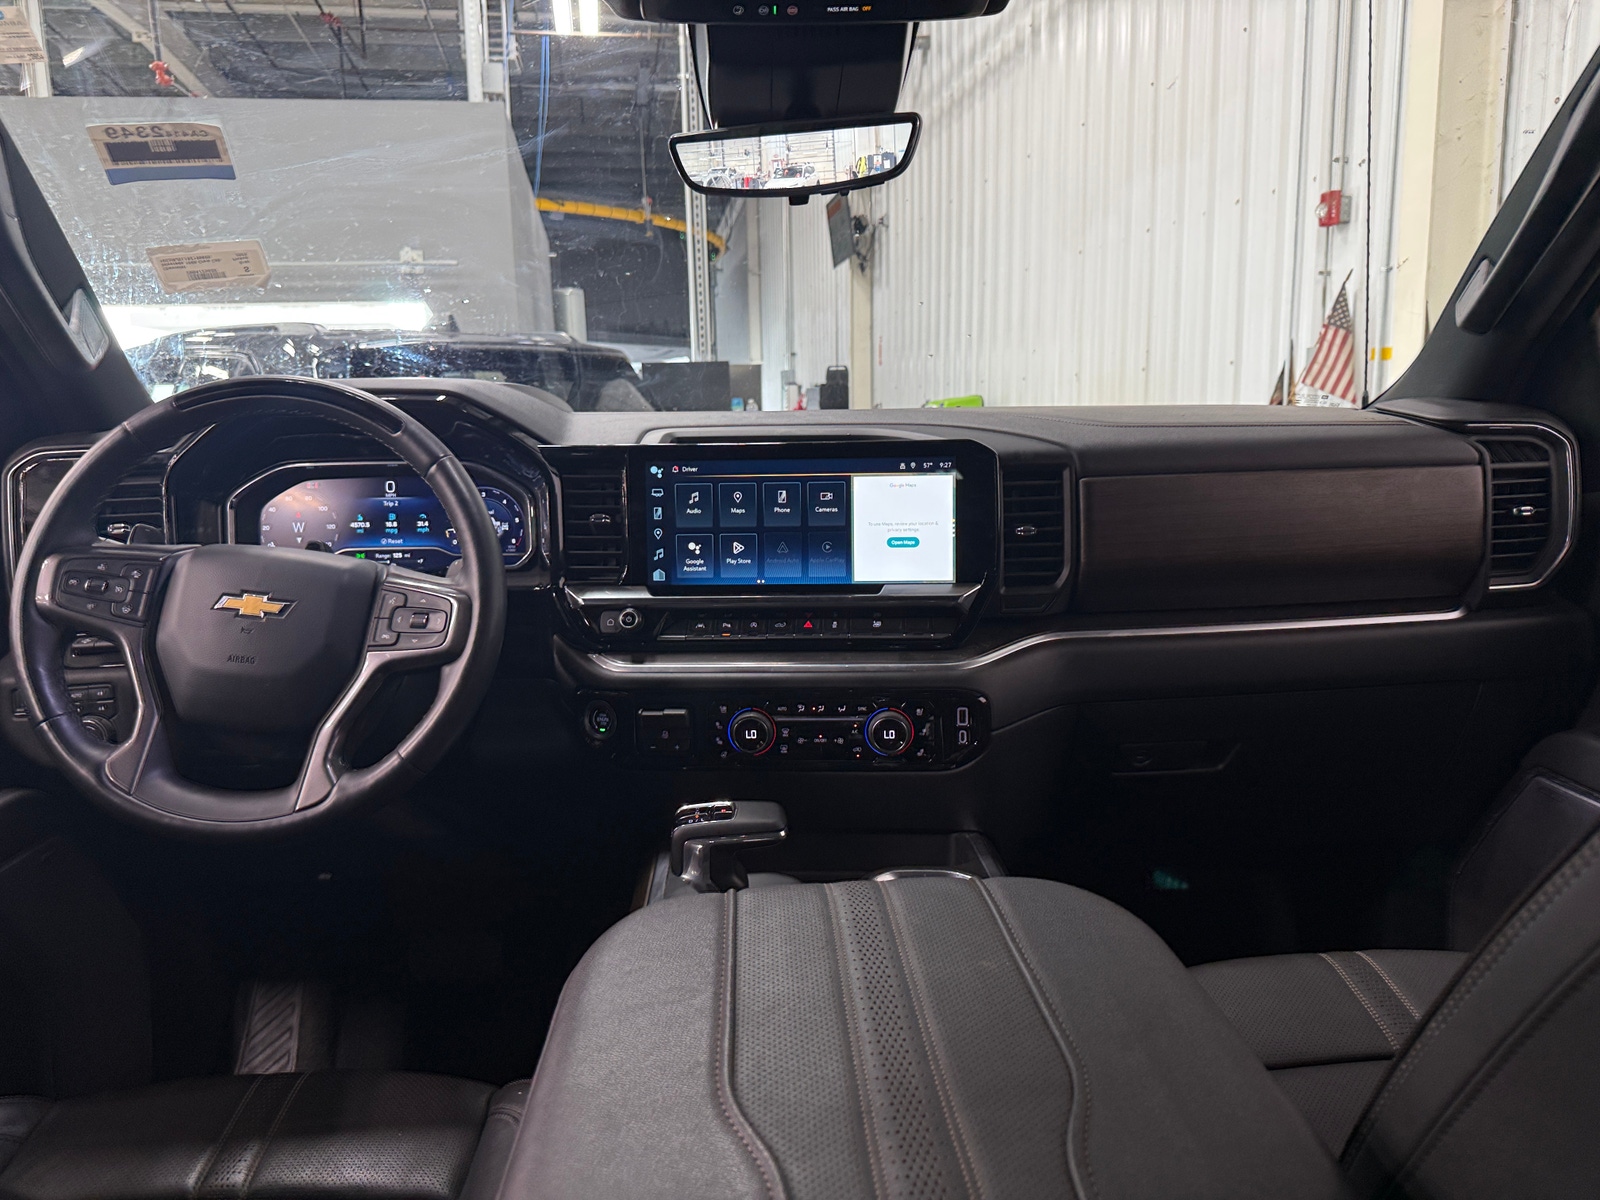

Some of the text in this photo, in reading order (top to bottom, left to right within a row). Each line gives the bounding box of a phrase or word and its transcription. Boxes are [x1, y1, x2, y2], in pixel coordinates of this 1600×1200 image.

[385, 480, 396, 493] 0
[383, 500, 394, 508] Trip
[292, 522, 305, 533] W
[686, 558, 704, 566] Google
[226, 654, 256, 665] AIRBAG
